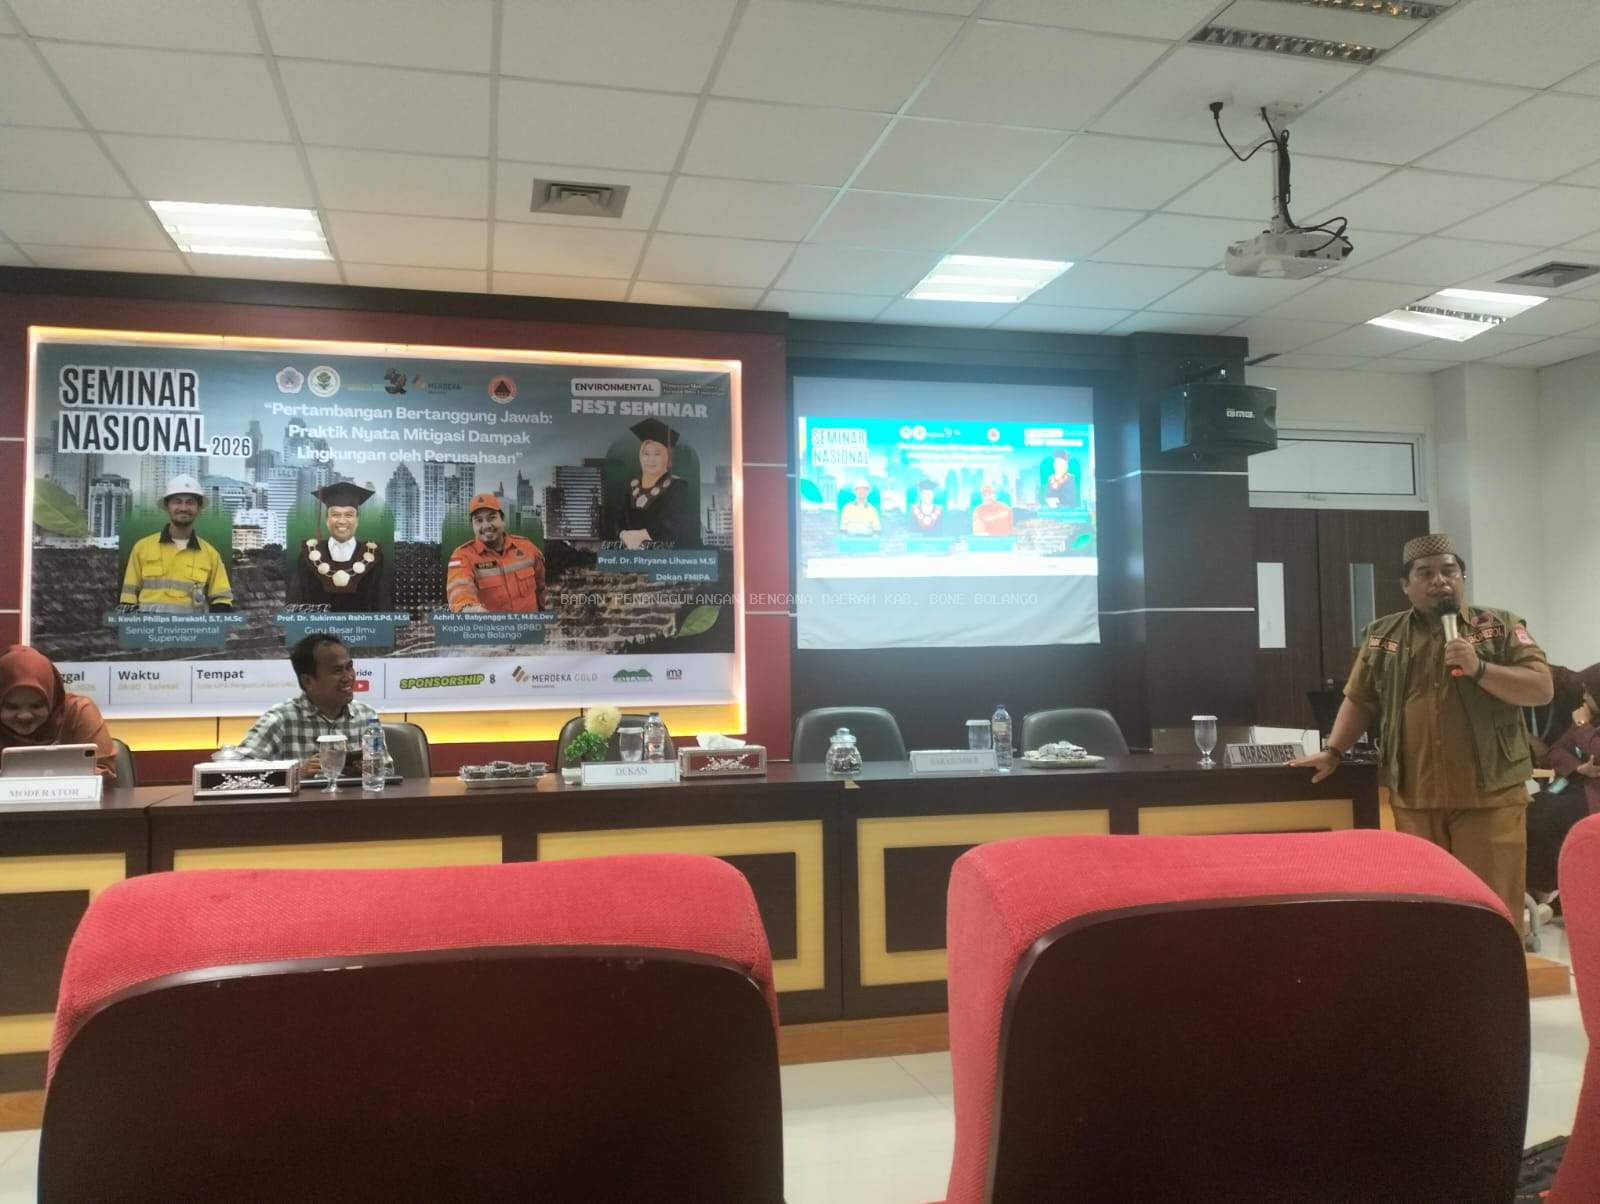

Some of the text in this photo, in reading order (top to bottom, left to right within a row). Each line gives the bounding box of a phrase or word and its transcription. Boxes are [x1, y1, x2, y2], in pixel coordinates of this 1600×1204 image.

[61, 368, 197, 408] SEMINAR
[574, 383, 655, 392] ENVIRONMENTAL
[571, 399, 709, 418] FEST SEMINAR
[396, 406, 497, 425] Bertanggung
[500, 411, 553, 425] Jawab:
[62, 413, 250, 457] NASIONAL 2026
[288, 424, 531, 446] Praktik Nyata Mitigasi Dampak
[813, 430, 865, 445] SEMINAR
[297, 445, 387, 463] Lingkungan
[390, 448, 422, 462] oleh
[814, 449, 869, 464] NASIONAL
[598, 557, 618, 565] Prof.
[620, 557, 633, 565] Dr.
[125, 626, 155, 635] Senior
[304, 626, 376, 634] Guru Besar Ilmu
[442, 623, 542, 633] Kepala Pelaksana BPBD
[148, 635, 197, 643] Supervisor
[463, 631, 522, 640] Bone Bolango
[118, 670, 160, 681] Waktu
[197, 669, 245, 682] Tempat
[400, 674, 485, 689] SPONSORSHIP
[532, 673, 572, 682] MERDEKA
[574, 673, 598, 682] GOLD
[615, 766, 648, 777] DEKAN
[9, 788, 80, 798] MODERATOR
